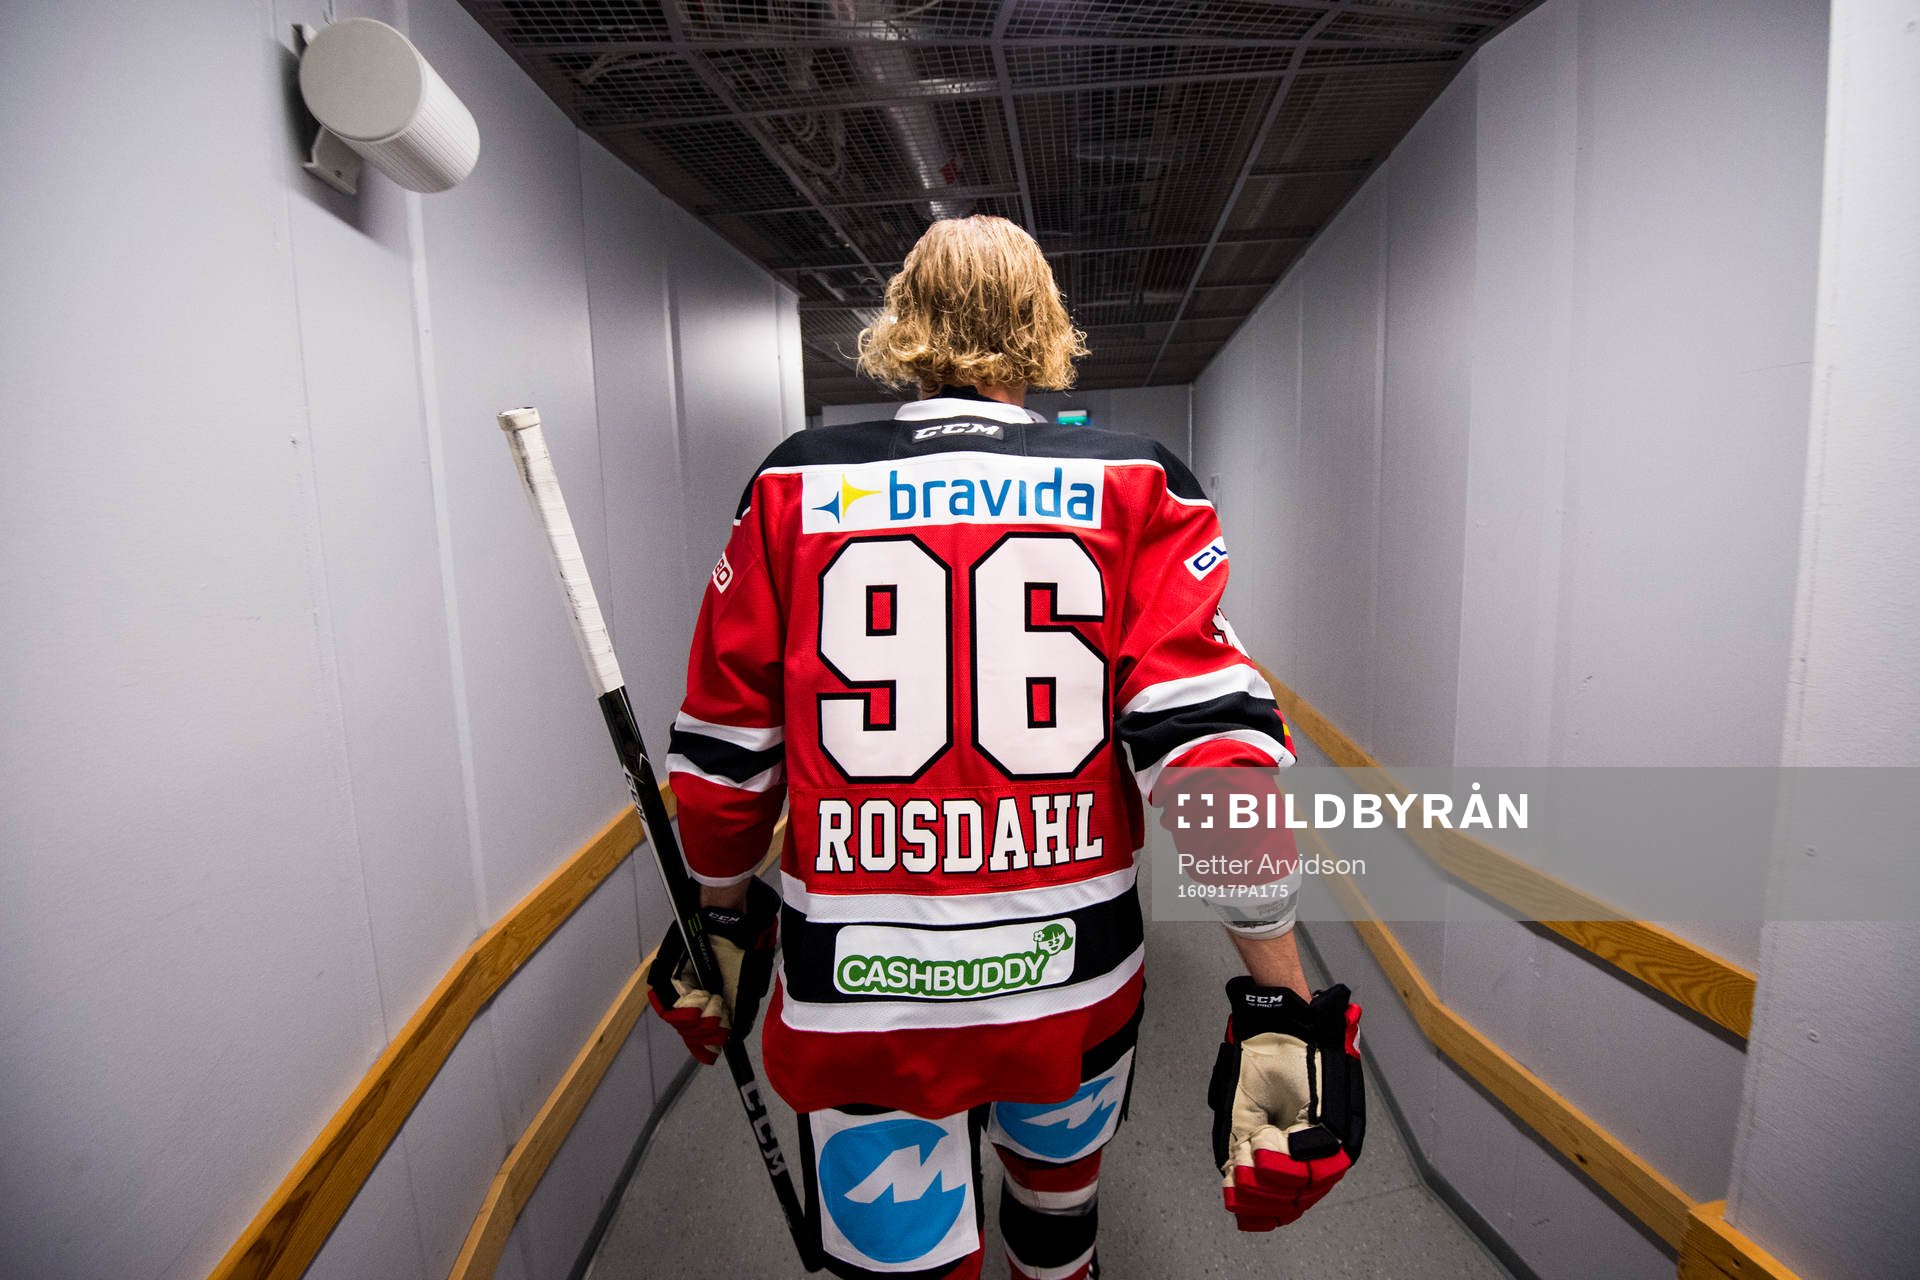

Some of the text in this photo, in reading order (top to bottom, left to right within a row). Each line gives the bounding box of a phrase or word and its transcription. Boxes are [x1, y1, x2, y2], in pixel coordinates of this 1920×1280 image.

[914, 423, 1000, 439] CCM
[889, 467, 1095, 521] bravida
[817, 532, 1109, 783] 96
[815, 792, 1104, 874] ROSDAHL
[841, 952, 1047, 993] CASHBUDDY
[1245, 994, 1284, 1004] CCM
[741, 1081, 788, 1177] CCM
